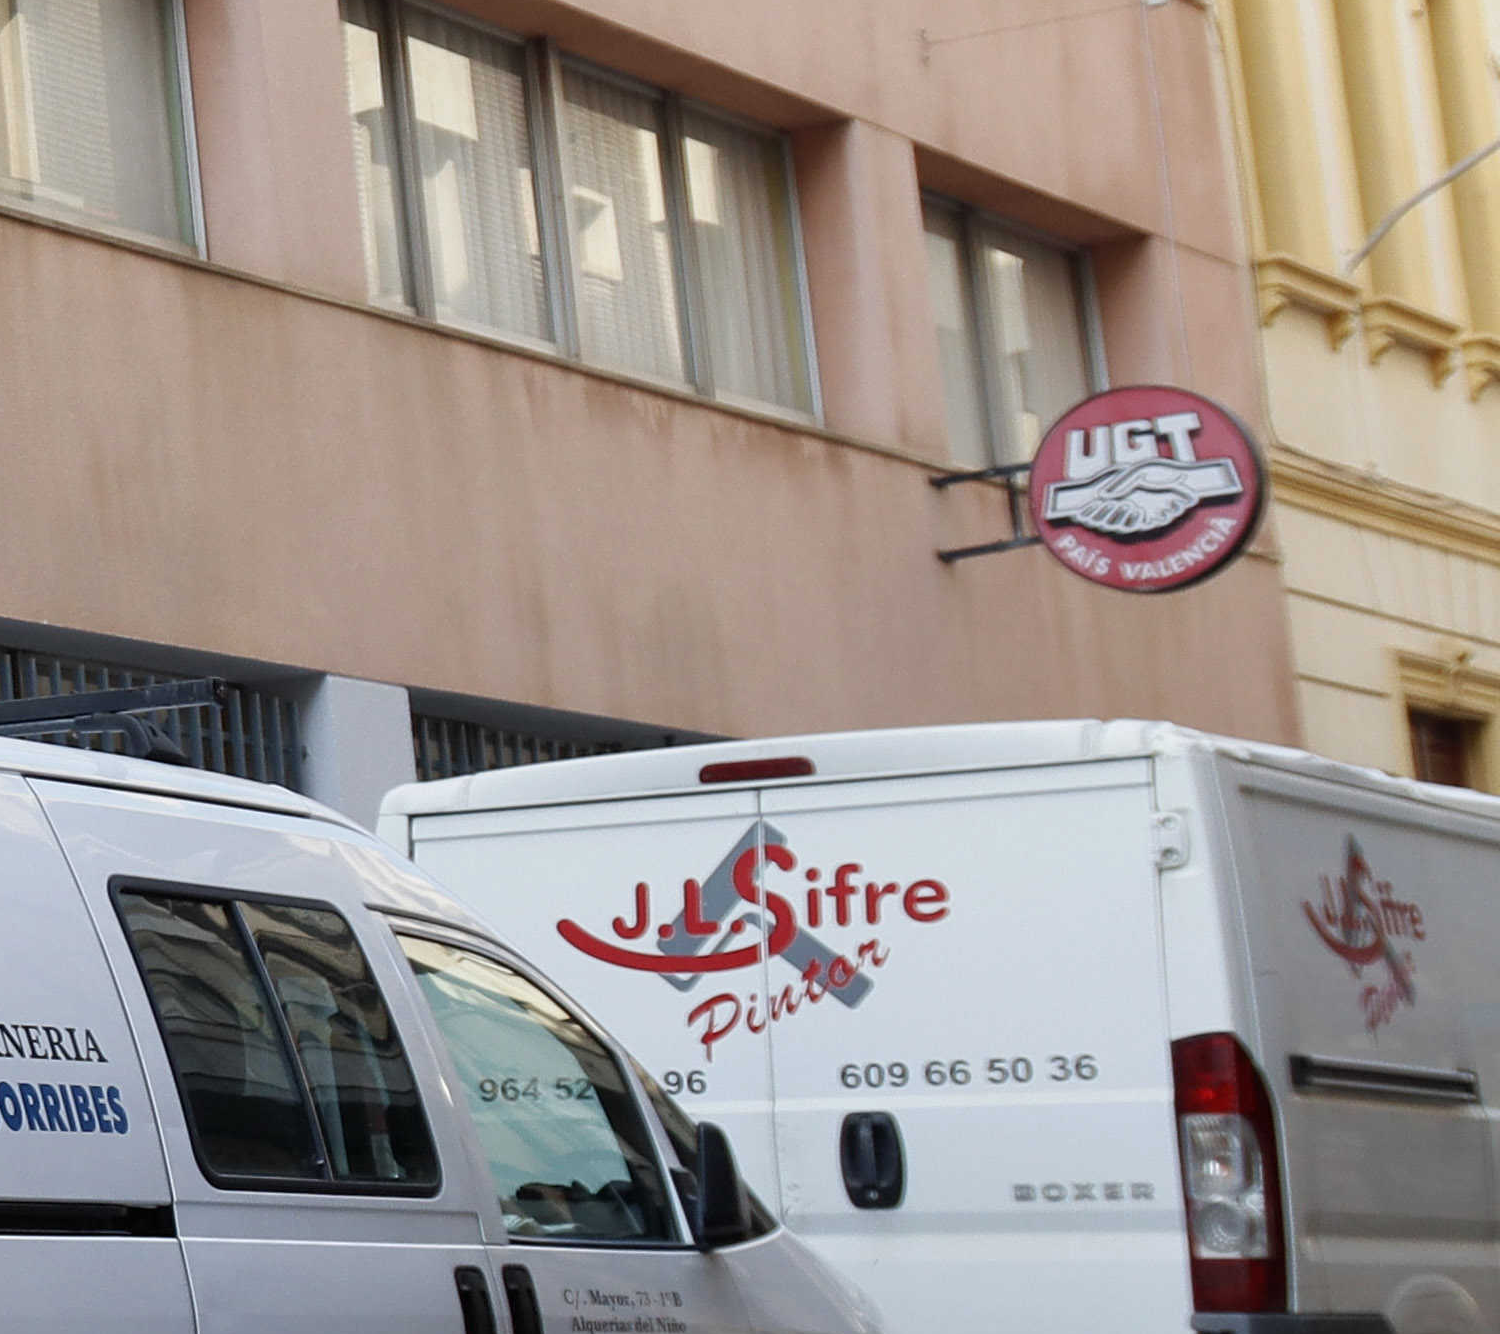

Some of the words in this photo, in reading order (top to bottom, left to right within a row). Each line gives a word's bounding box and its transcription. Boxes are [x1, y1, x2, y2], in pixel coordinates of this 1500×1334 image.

[1065, 412, 1202, 478] UGT
[687, 937, 891, 1062] Pintor
[479, 1077, 541, 1102] 964
[555, 1077, 595, 1101] 52
[663, 1069, 707, 1095] 96
[840, 1062, 910, 1089] 609
[924, 1060, 972, 1086] 66
[986, 1057, 1034, 1084] 50
[1049, 1054, 1099, 1082] 36
[1013, 1181, 1156, 1203] BOXER
[634, 1316, 653, 1333] del
